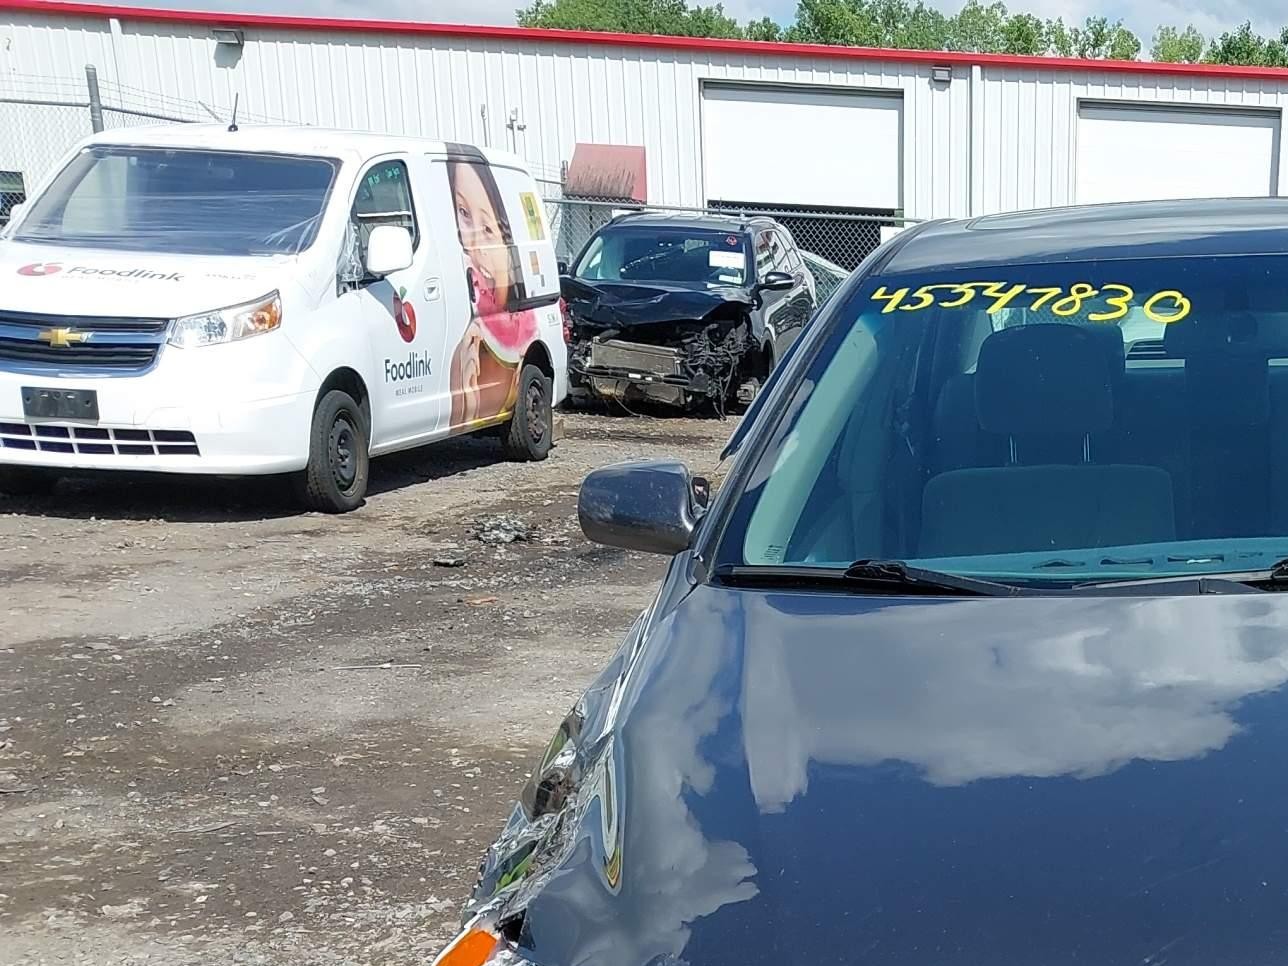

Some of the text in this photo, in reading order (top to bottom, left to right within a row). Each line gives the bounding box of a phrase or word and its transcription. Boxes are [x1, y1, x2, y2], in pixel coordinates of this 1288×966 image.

[67, 266, 185, 282] Foodlink
[870, 281, 1191, 323] 45547830
[385, 350, 432, 383] Foodlink
